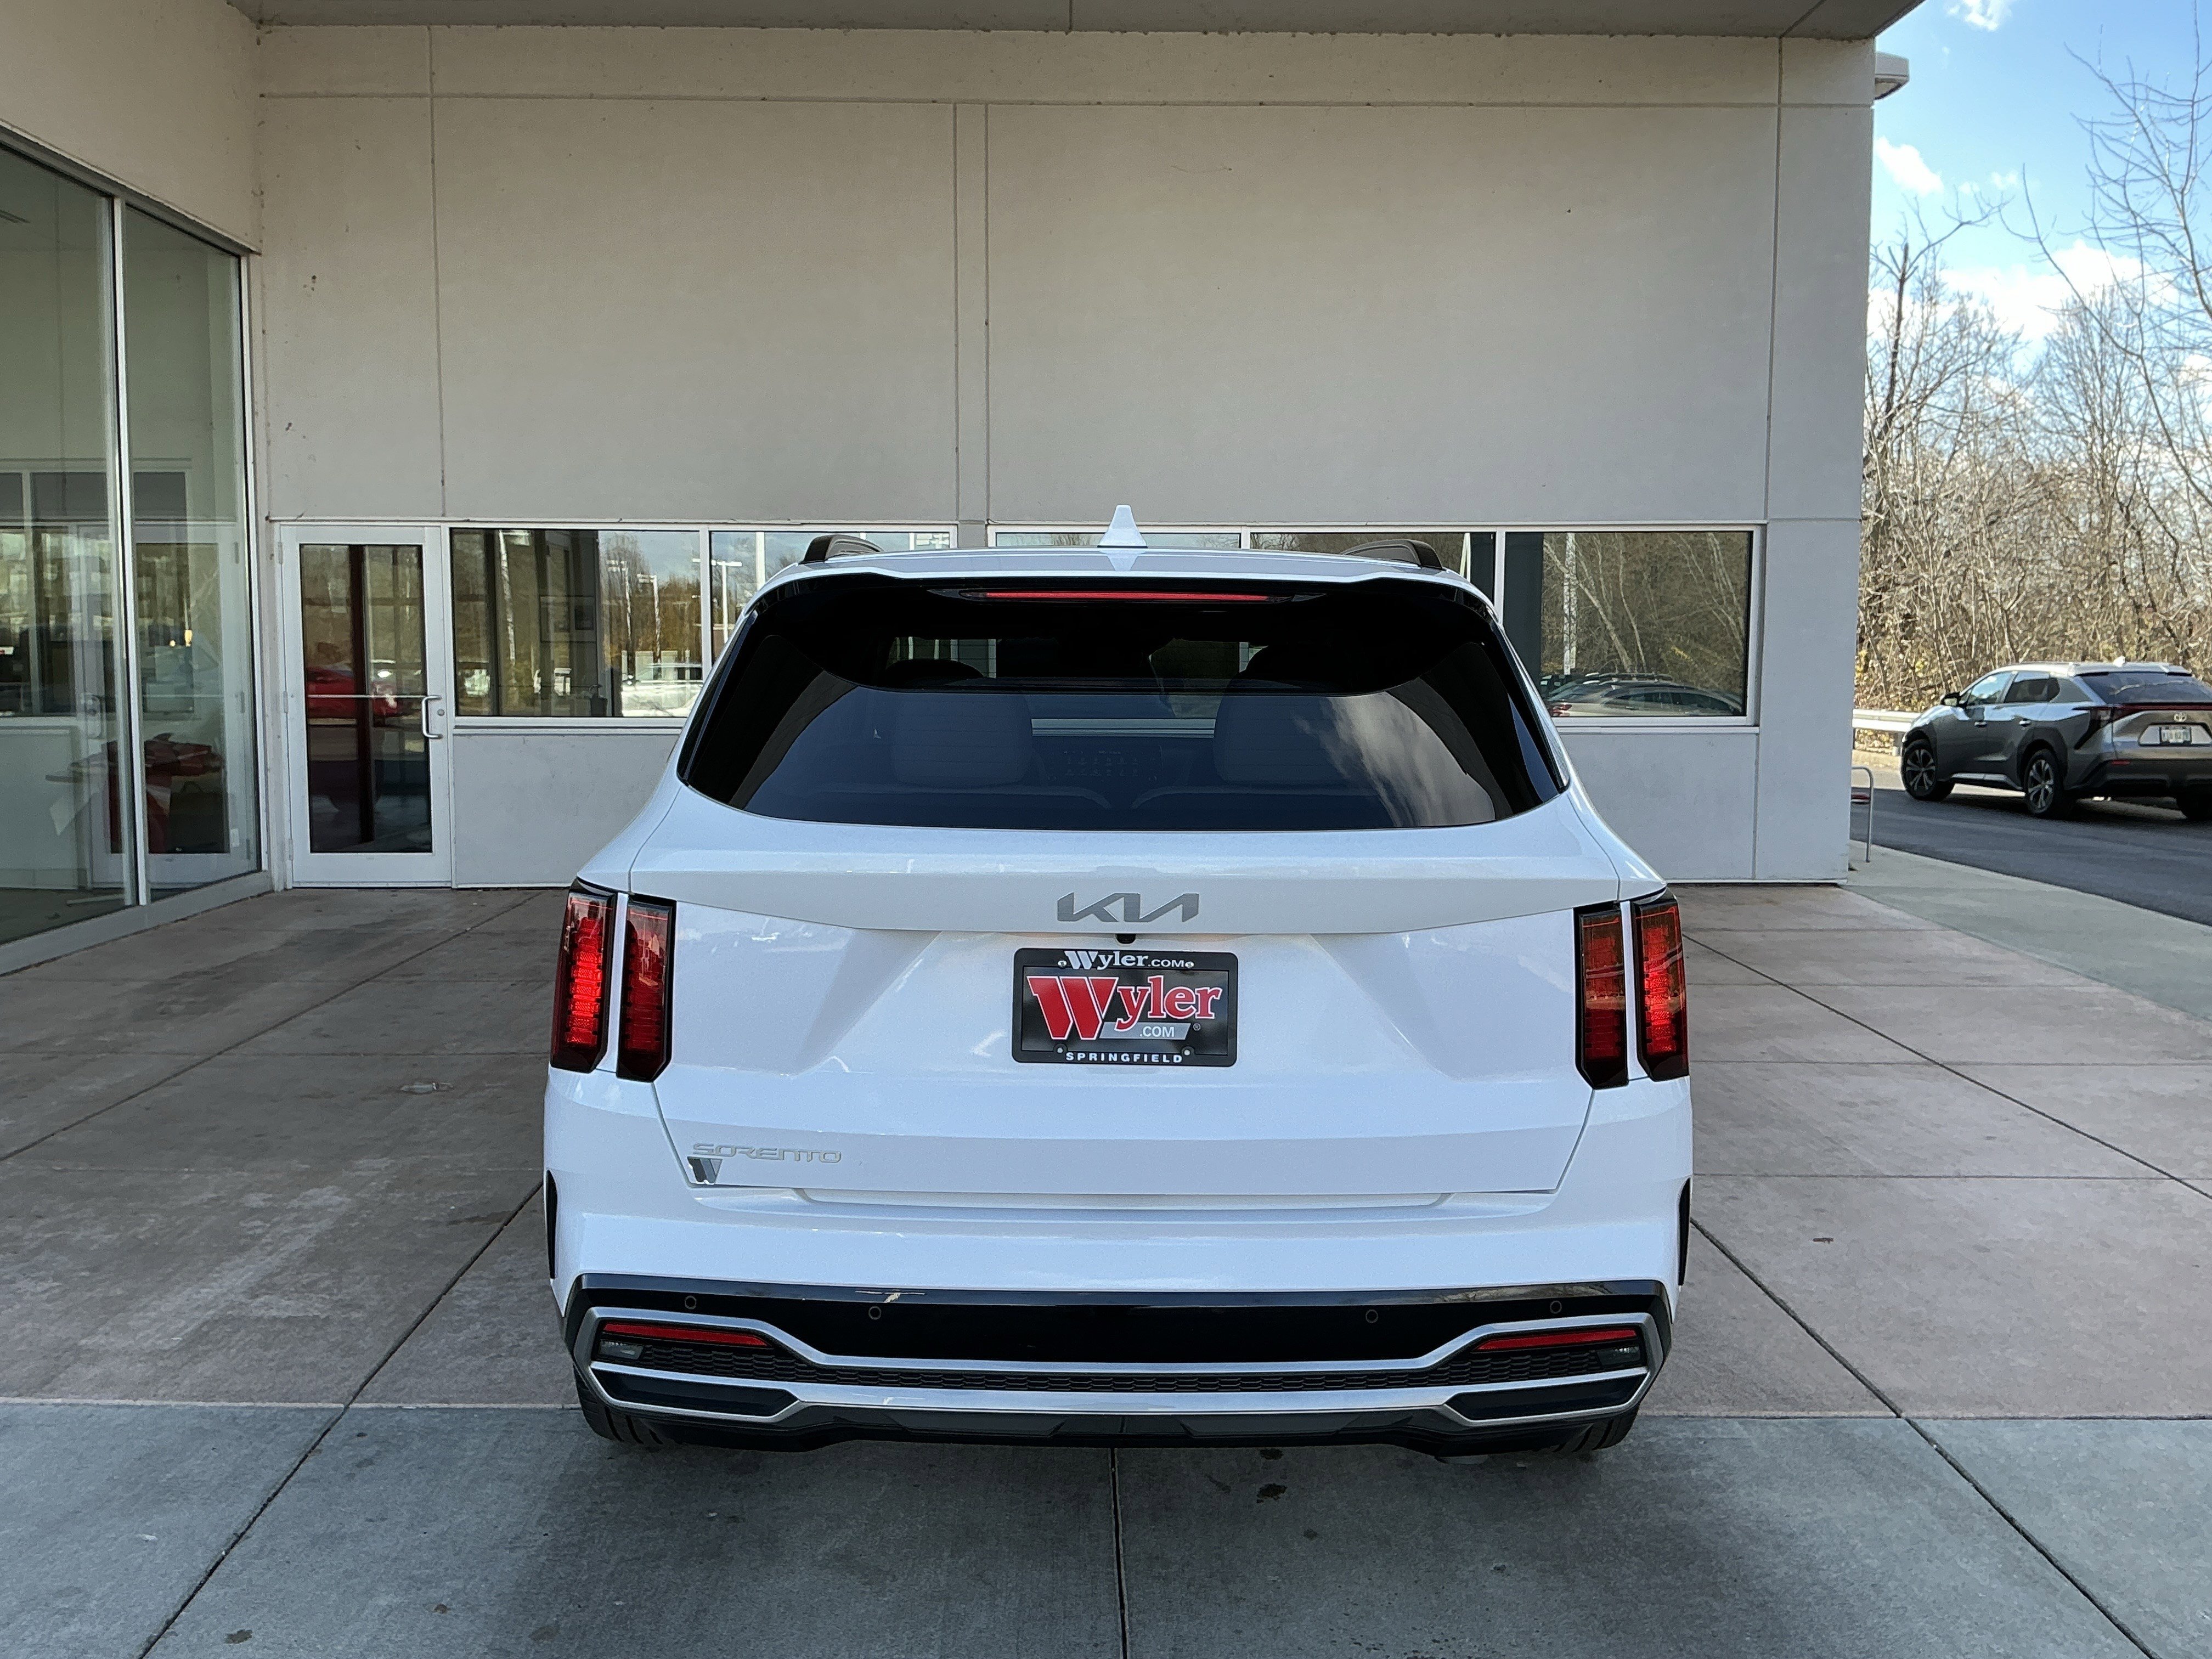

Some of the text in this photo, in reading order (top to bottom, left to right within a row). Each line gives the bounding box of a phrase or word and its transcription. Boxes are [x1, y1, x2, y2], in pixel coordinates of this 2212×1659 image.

[1026, 975, 1223, 1040] Wyler
[1065, 1052, 1183, 1063] SPRINGFIELD
[693, 1143, 842, 1163] SORENTO
